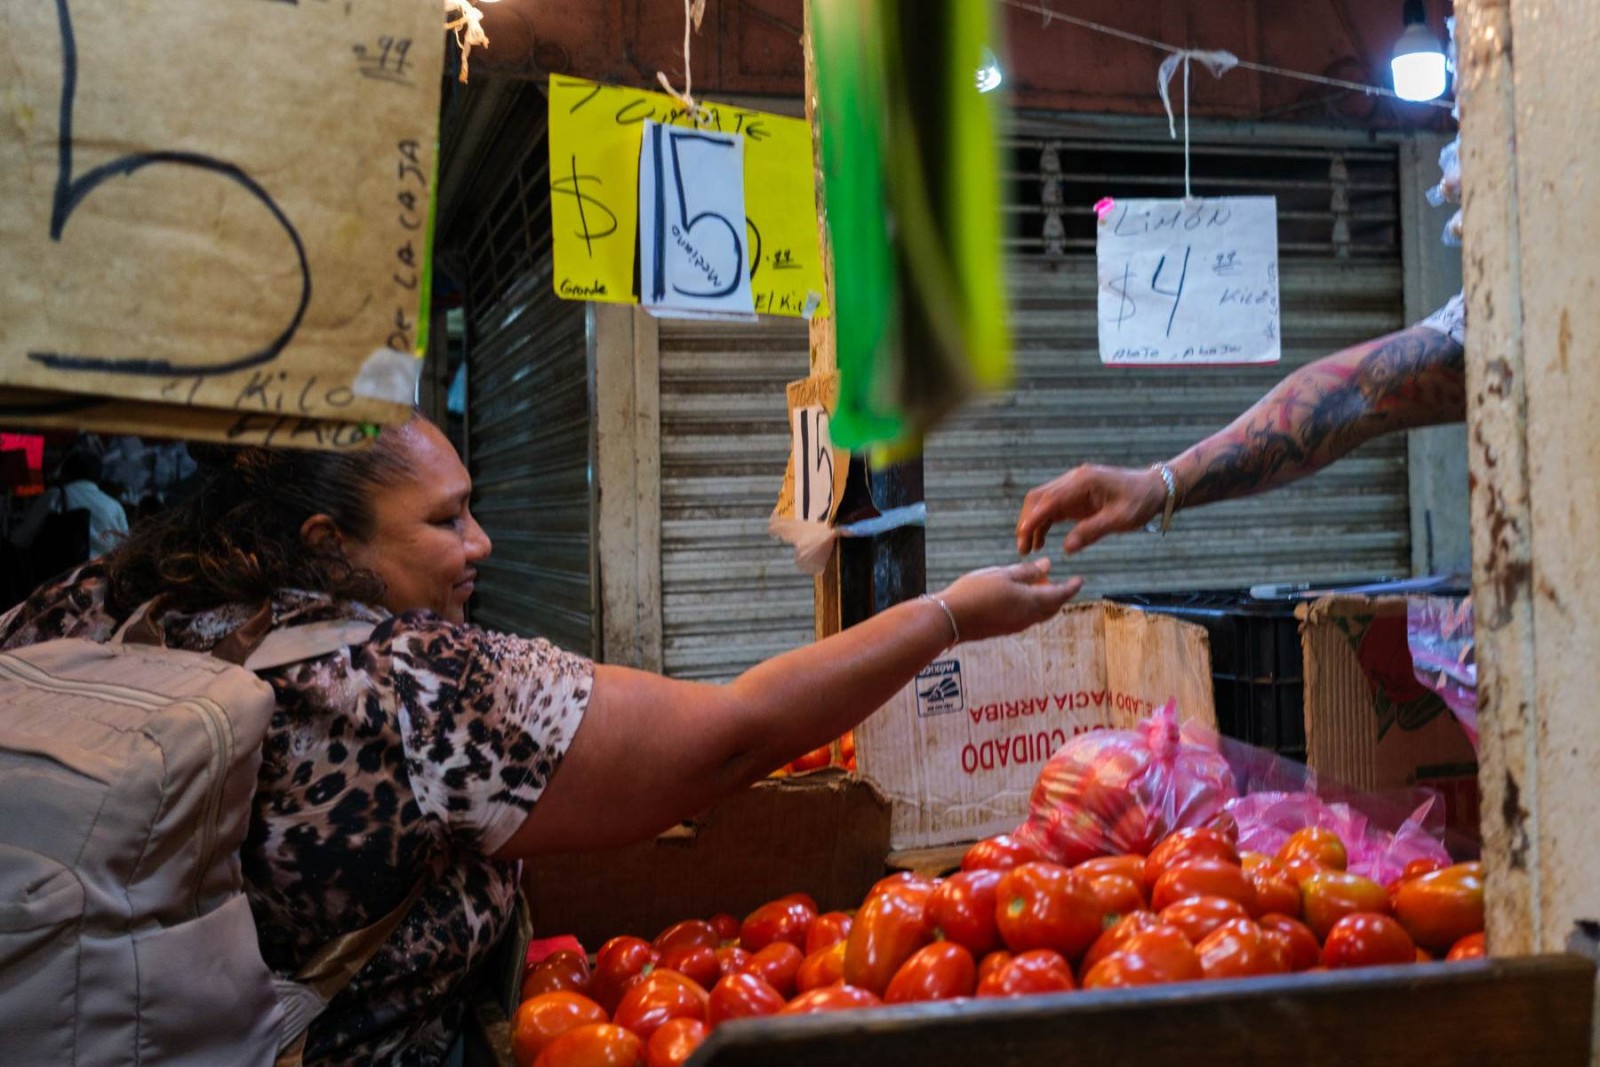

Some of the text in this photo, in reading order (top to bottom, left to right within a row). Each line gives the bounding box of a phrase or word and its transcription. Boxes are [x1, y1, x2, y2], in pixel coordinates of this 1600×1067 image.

[550, 154, 617, 258] $
[651, 123, 743, 303] 15
[1107, 262, 1137, 332] $
[1151, 245, 1191, 338] 4
[961, 728, 1066, 775] CUIDADO
[969, 695, 1049, 724] ARRIBA
